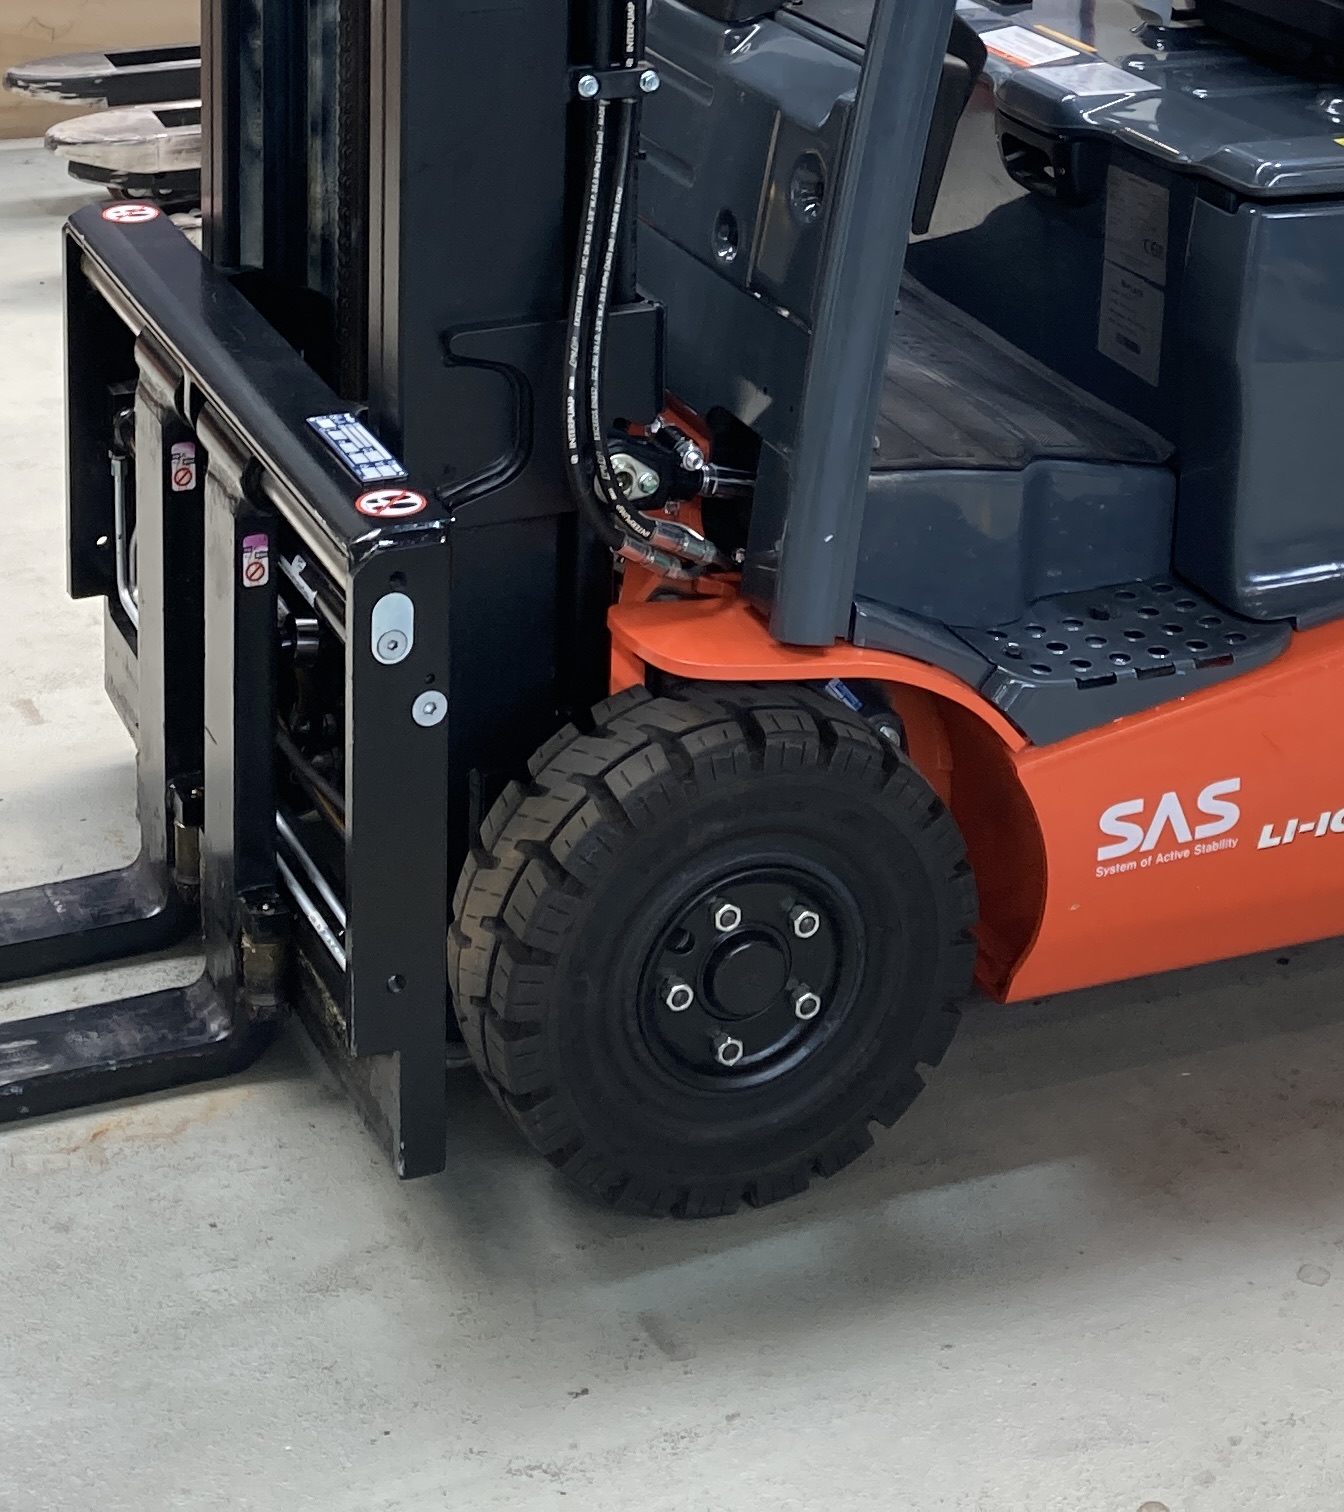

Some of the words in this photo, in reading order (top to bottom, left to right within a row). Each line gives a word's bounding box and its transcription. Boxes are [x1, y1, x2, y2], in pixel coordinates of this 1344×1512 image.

[1097, 777, 1241, 862] SAS
[1095, 861, 1137, 878] System
[1140, 856, 1153, 868] of
[1155, 848, 1191, 865] Active
[1194, 838, 1239, 856] Stability
